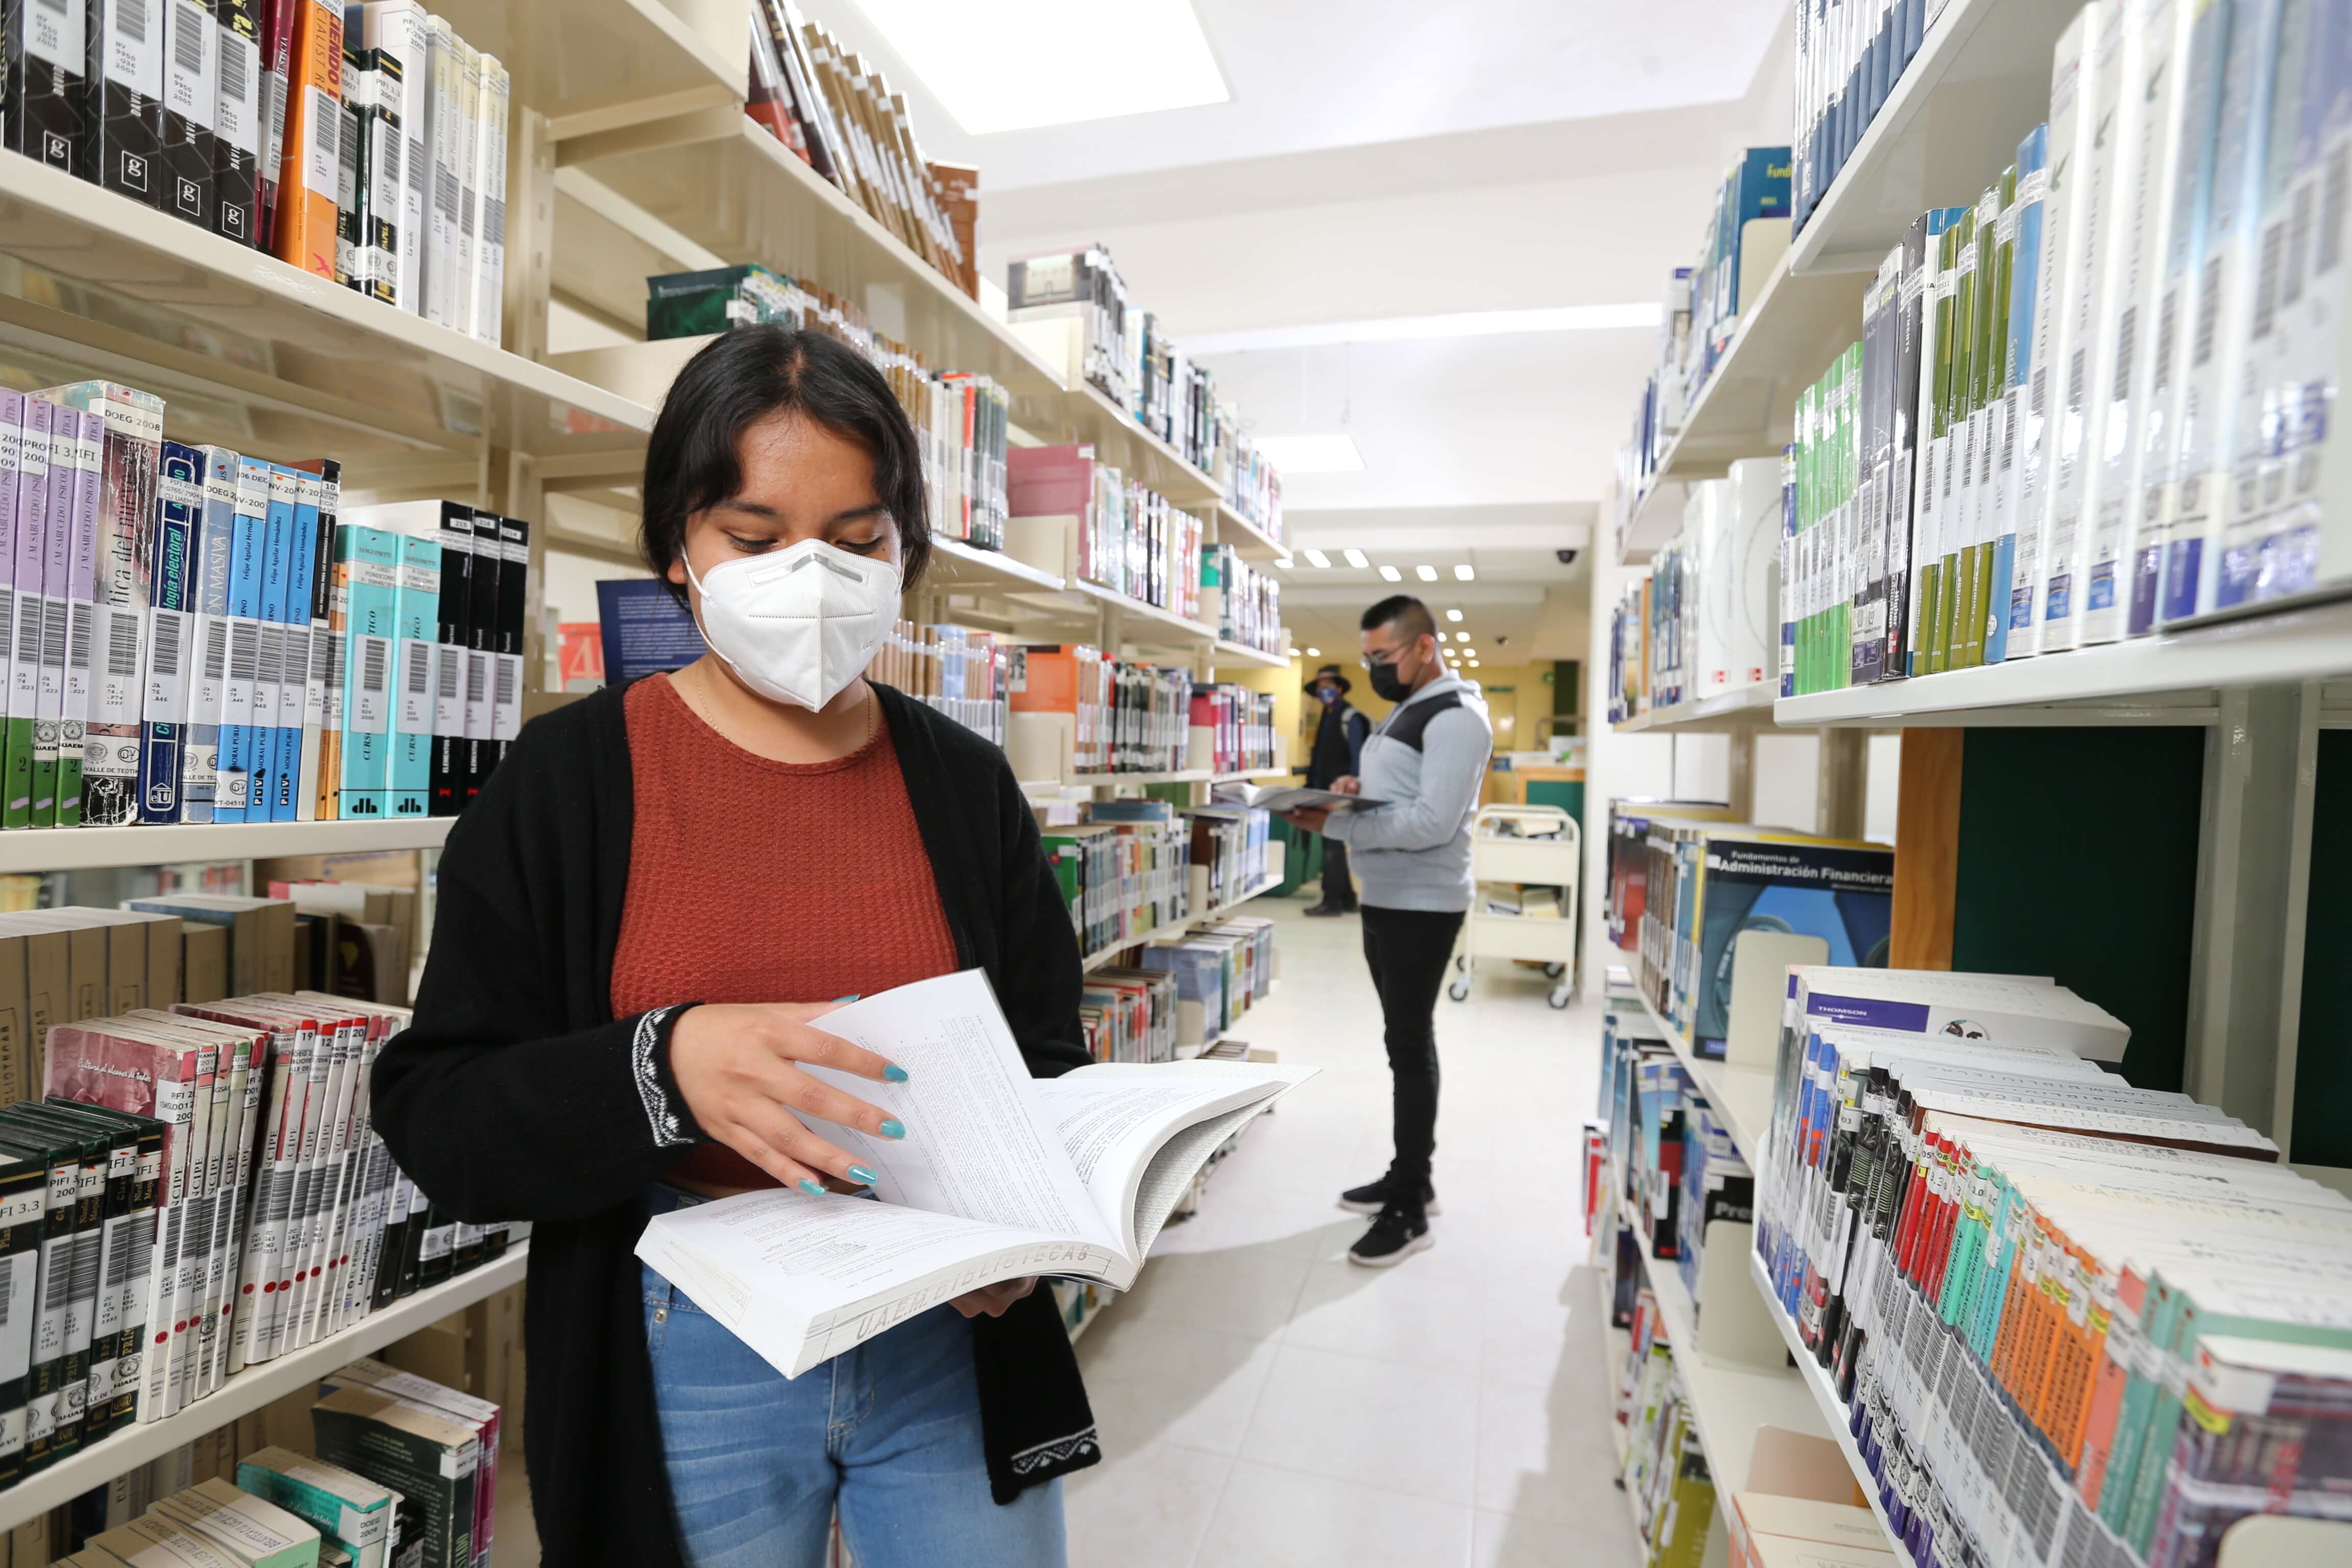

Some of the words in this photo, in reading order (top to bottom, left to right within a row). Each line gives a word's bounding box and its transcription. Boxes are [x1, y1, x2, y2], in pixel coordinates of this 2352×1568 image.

[376, 78, 389, 90] PIFI
[380, 91, 397, 104] 2007
[105, 409, 133, 424] DOEG
[136, 420, 161, 431] 2008
[170, 479, 183, 488] PIFI
[184, 481, 199, 491] 2010
[206, 485, 229, 498] DOEG
[175, 495, 193, 504] UAEM
[30, 499, 40, 543] SABUCEDO
[56, 505, 66, 549] SABUCEDO
[82, 508, 92, 552] SABUCEDO
[273, 516, 281, 547] Hernández
[299, 522, 307, 552] Hernández
[165, 528, 181, 578] electoral
[244, 541, 253, 562] Aguilar
[272, 547, 280, 568] Aguilar
[212, 536, 227, 591] MASIVA
[298, 552, 306, 572] Aguilar
[243, 563, 251, 581] Felipe
[271, 569, 279, 585] Felipe
[1731, 850, 1787, 863] Fundamentos
[1721, 859, 1818, 878] Administración
[1820, 867, 1895, 885] Financiera
[1818, 1006, 1867, 1016] THOMSON
[302, 1032, 312, 1042] 19
[322, 1038, 332, 1047] 12
[337, 1030, 347, 1039] 21
[78, 1058, 100, 1071] Cultura
[50, 1178, 69, 1188] PIFI
[18, 1201, 39, 1215] 3.3
[1941, 1230, 1963, 1317] ADMINISTRACIÓN
[1959, 1239, 1982, 1328] ADMINISTRACIÓN
[360, 1516, 380, 1528] DOEG
[360, 1527, 378, 1538] 2009
